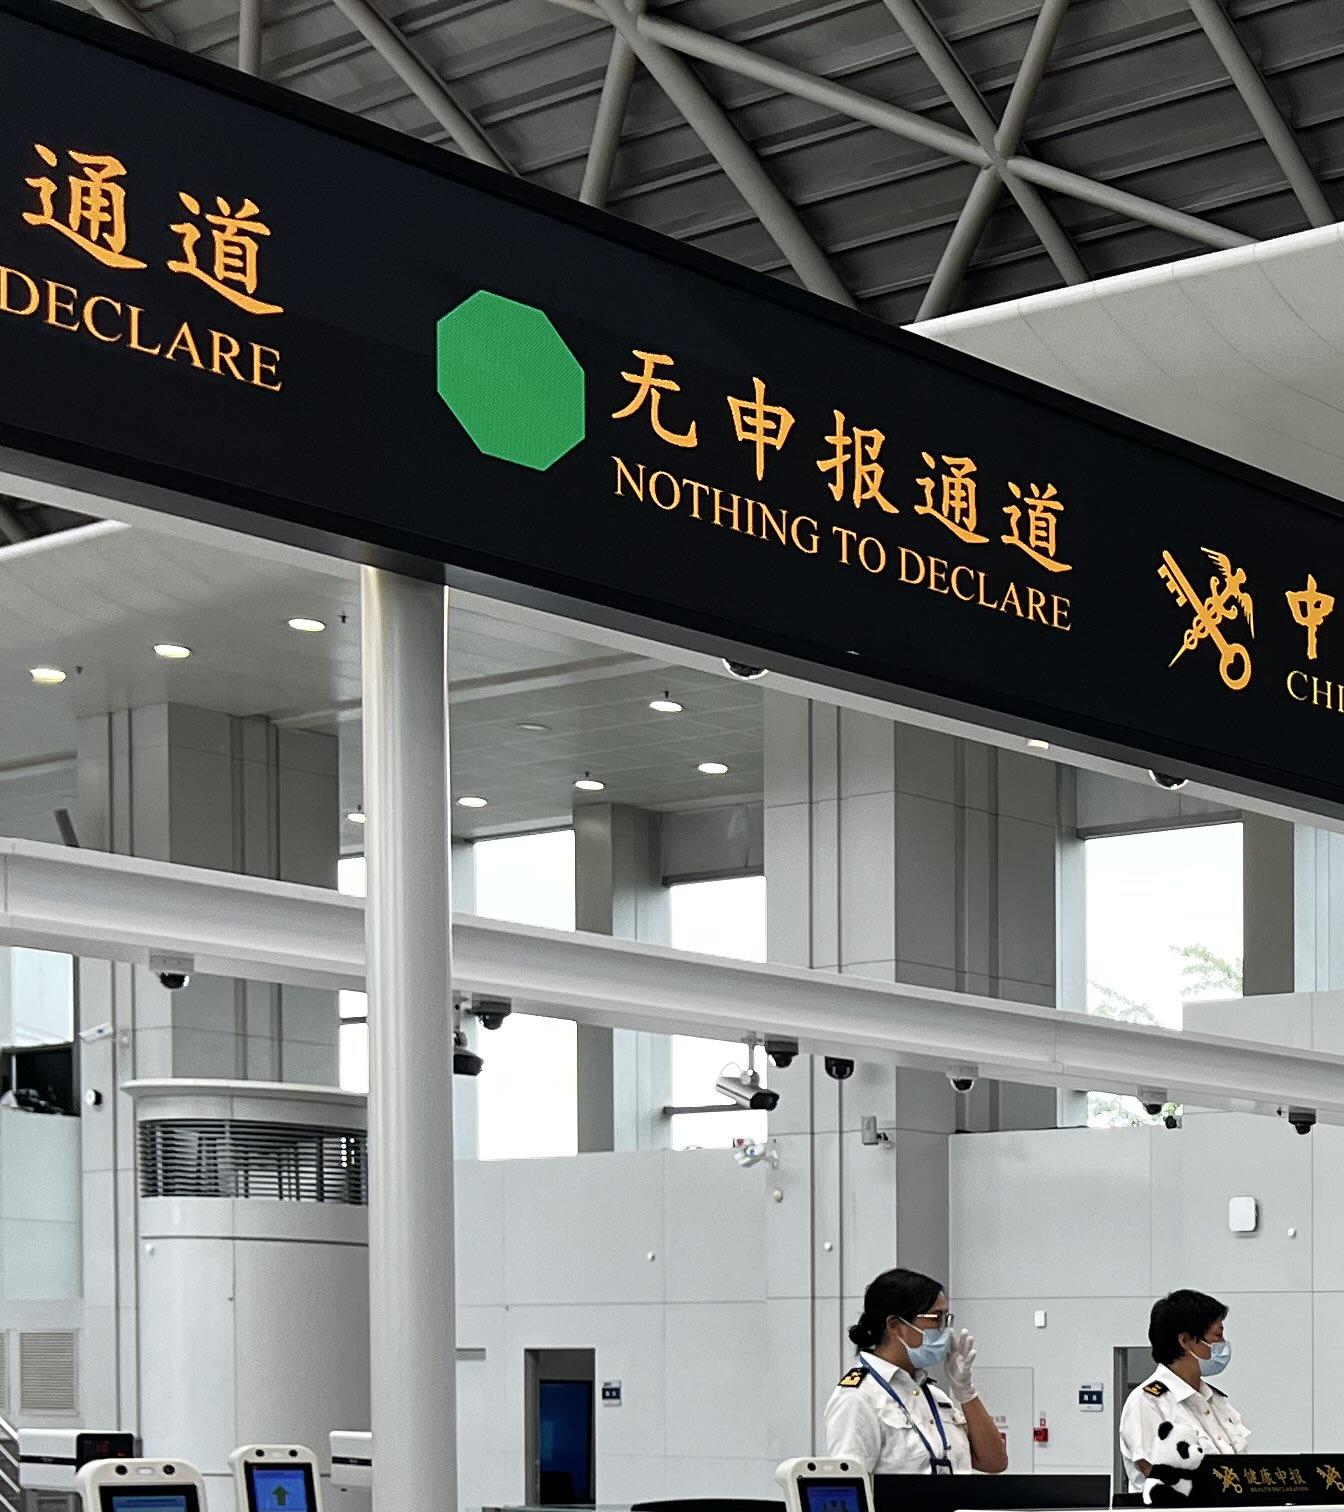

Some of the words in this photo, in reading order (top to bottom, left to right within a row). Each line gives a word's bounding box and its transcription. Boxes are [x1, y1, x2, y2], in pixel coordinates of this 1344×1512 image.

[22, 144, 284, 316] 通道
[0, 266, 282, 393] DECLARE
[612, 350, 1073, 574] 无申报通道
[613, 457, 821, 554] NOTHING
[833, 525, 887, 577] TO
[899, 547, 1070, 631] DECLARE
